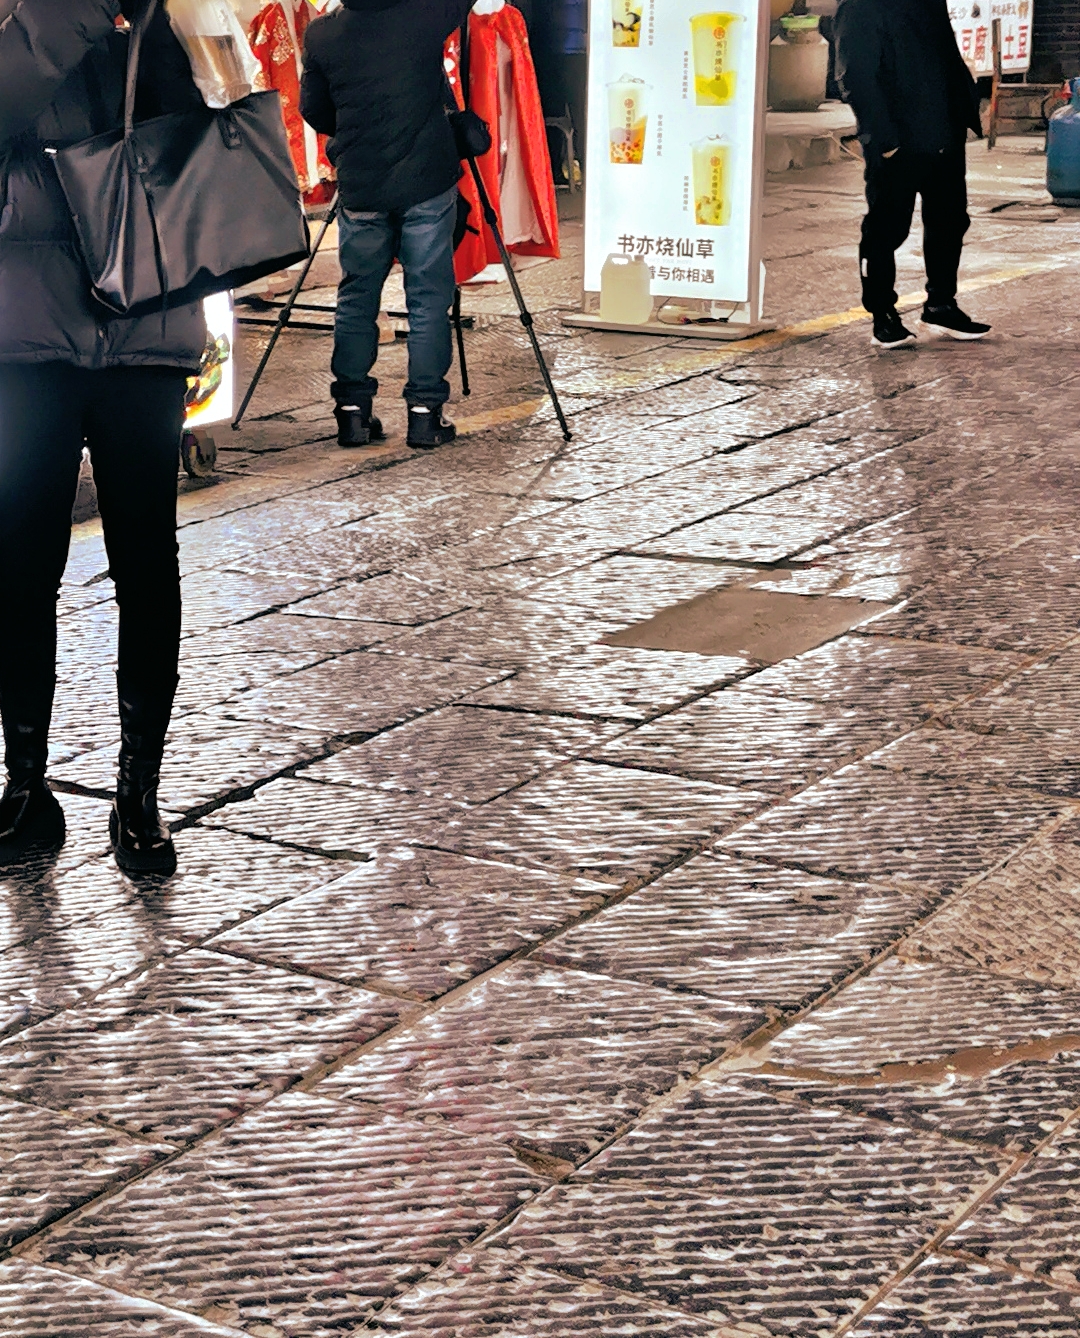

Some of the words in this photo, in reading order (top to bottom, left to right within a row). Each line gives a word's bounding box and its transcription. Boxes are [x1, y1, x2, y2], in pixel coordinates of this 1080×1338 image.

[617, 233, 715, 259] 书亦烧仙草
